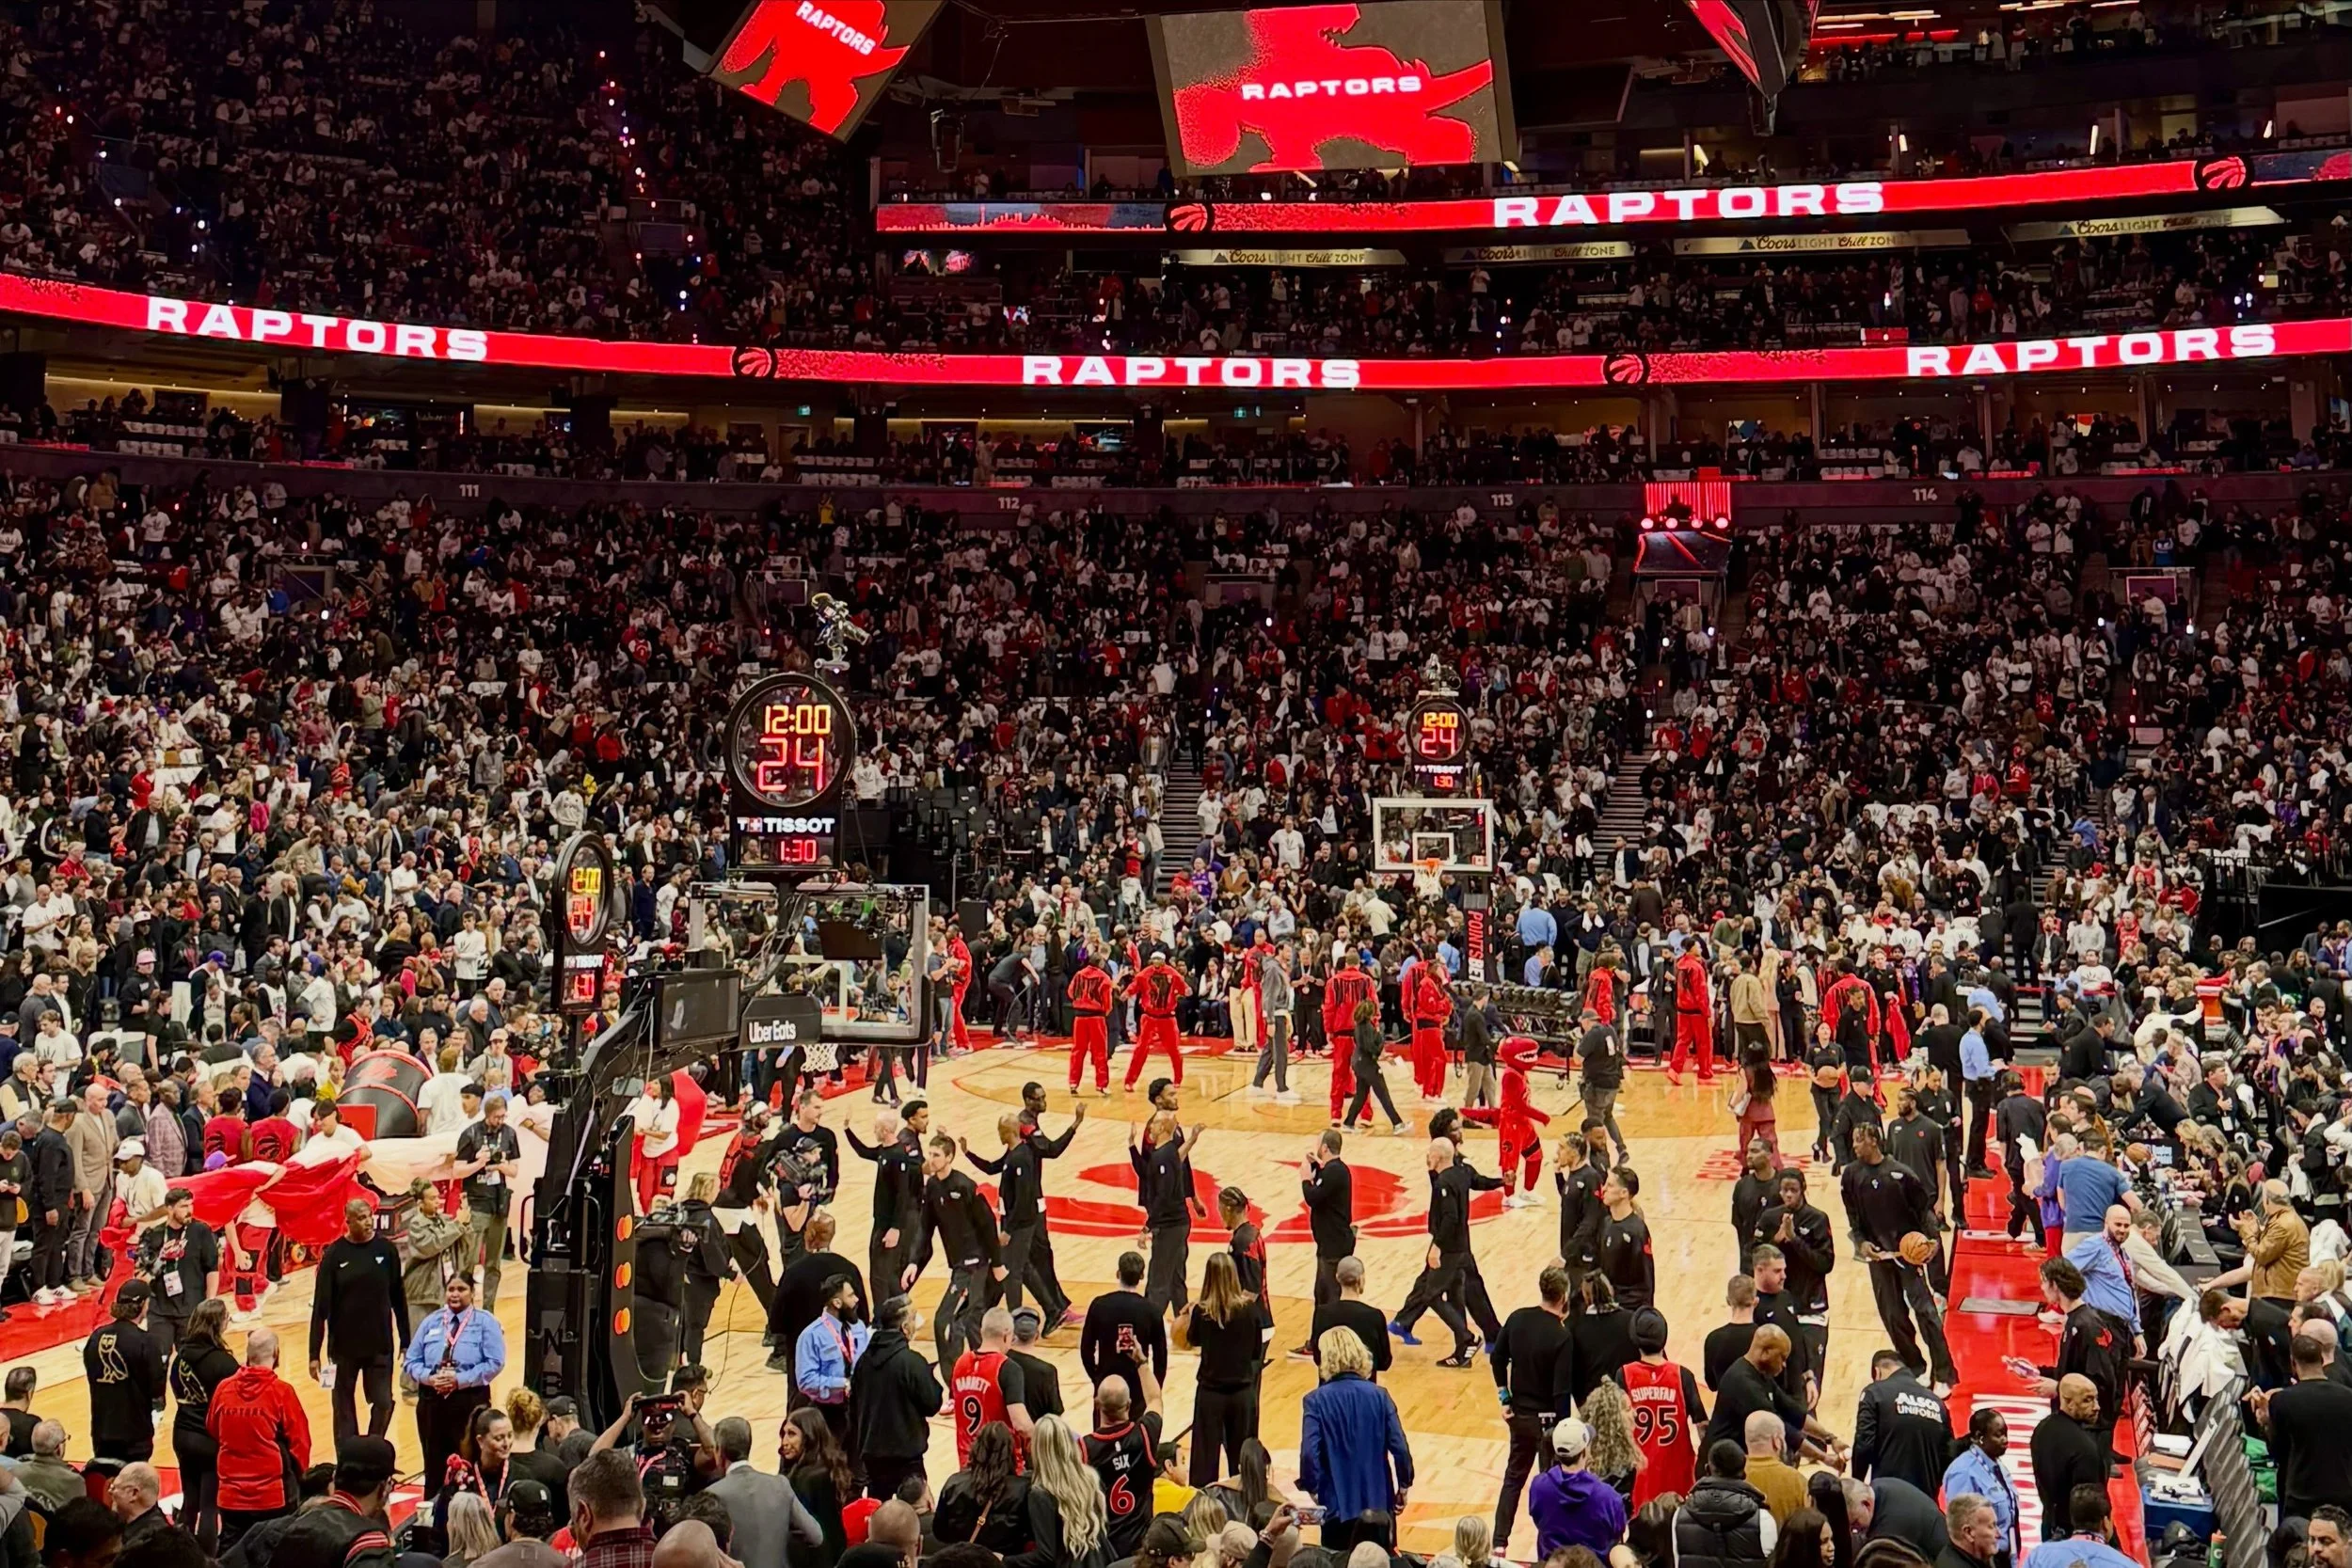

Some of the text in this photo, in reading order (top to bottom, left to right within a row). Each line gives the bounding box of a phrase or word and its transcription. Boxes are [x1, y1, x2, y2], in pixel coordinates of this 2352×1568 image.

[796, 1, 876, 55] RAPTORS
[1242, 76, 1422, 101] RAPTORS
[1493, 182, 1883, 229] RAPTORS
[2076, 220, 2118, 234] Coors
[2120, 218, 2158, 231] LIGHT
[1477, 245, 1515, 261] Coors
[1553, 245, 1582, 258] Chill
[1756, 235, 1902, 249] Coors LIGHT Chill ZON
[1229, 248, 1266, 263] Coors
[1268, 253, 1301, 263] LIGHT
[1306, 253, 1332, 263] Chill
[146, 296, 487, 361] RAPTORS
[1907, 325, 2275, 376] RAPTORS
[1022, 356, 1359, 390] RAPTORS
[459, 485, 479, 497] 111
[1491, 494, 1513, 506] 113
[1913, 488, 1937, 501] 114
[998, 498, 1019, 509] 112
[765, 705, 832, 735] 12:00
[1423, 712, 1458, 728] 12:00
[1422, 727, 1455, 754] 24
[758, 737, 825, 791] 24
[764, 817, 835, 833] TISSOT
[780, 839, 817, 863] 1:30
[749, 1020, 797, 1043] Uber Eats
[1630, 1386, 1677, 1402] SUPERFAN
[963, 1395, 983, 1436] 9
[1634, 1405, 1679, 1447] 95
[1112, 1453, 1131, 1471] SIX
[1109, 1473, 1136, 1515] 6
